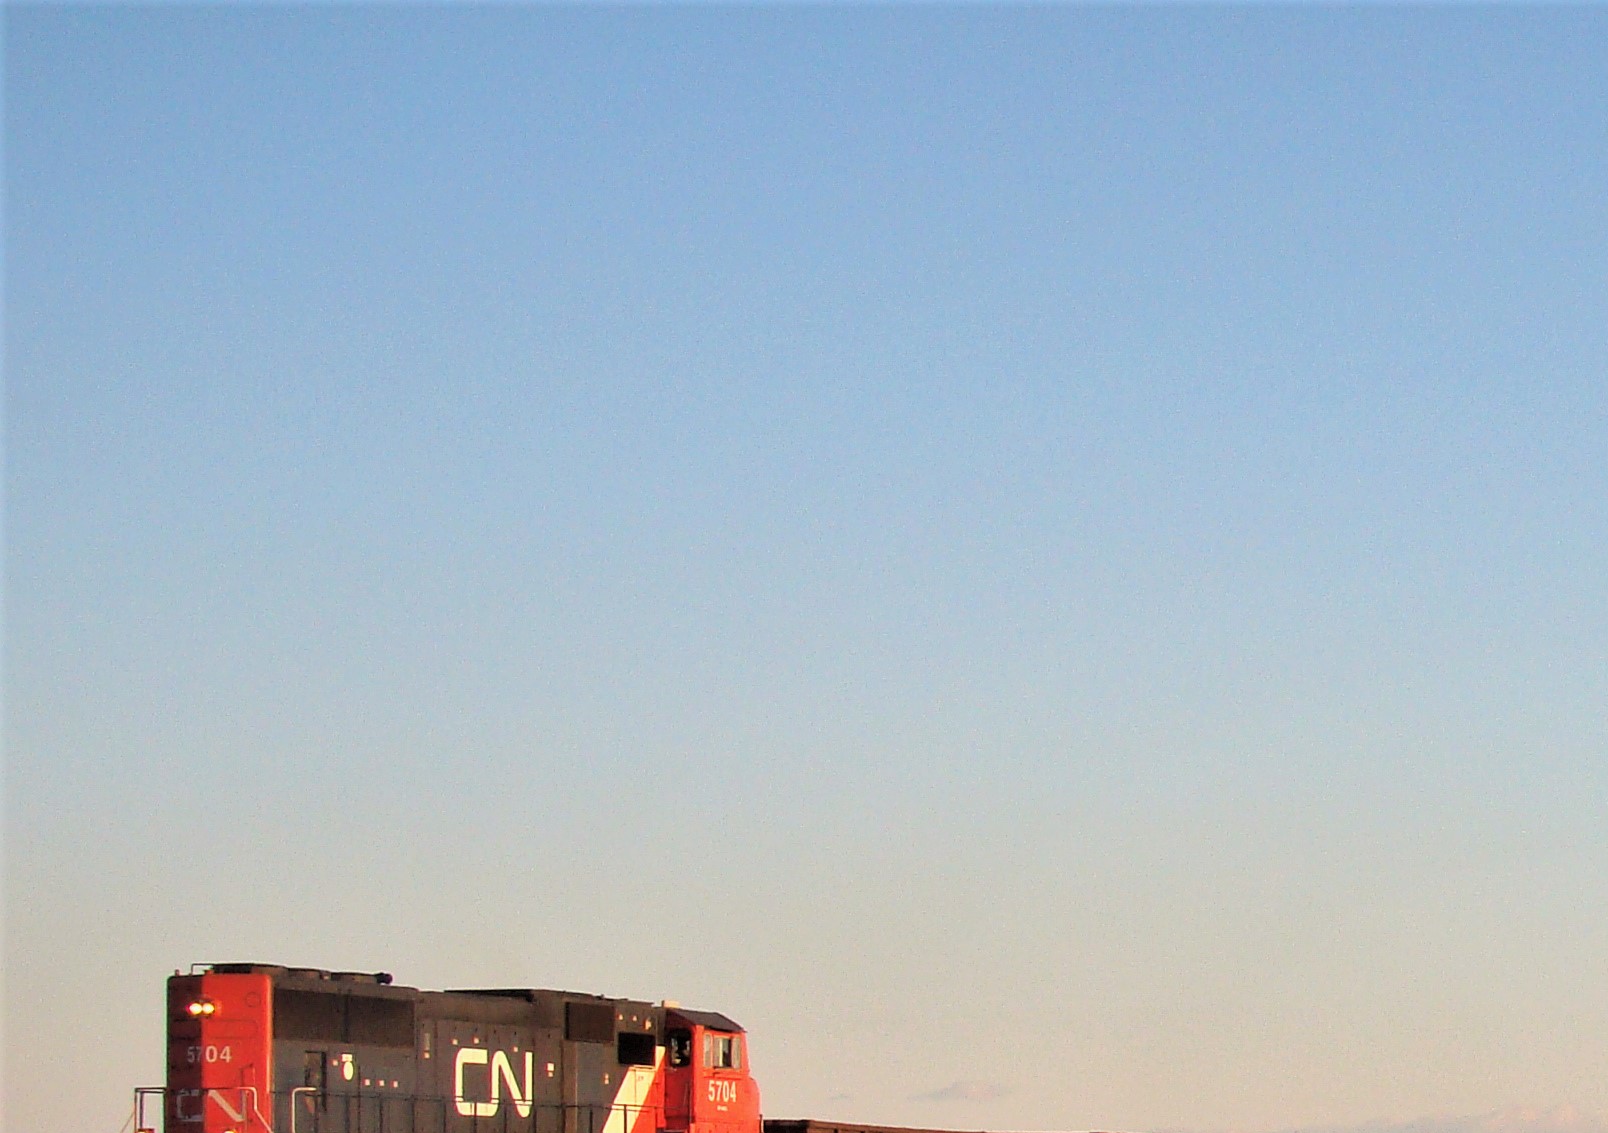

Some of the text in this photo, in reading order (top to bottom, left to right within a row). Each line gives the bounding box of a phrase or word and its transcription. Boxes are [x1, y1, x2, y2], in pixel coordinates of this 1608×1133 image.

[187, 1045, 232, 1063] 5704
[455, 1047, 533, 1118] CN
[708, 1079, 737, 1103] 5704
[176, 1088, 247, 1122] CN
